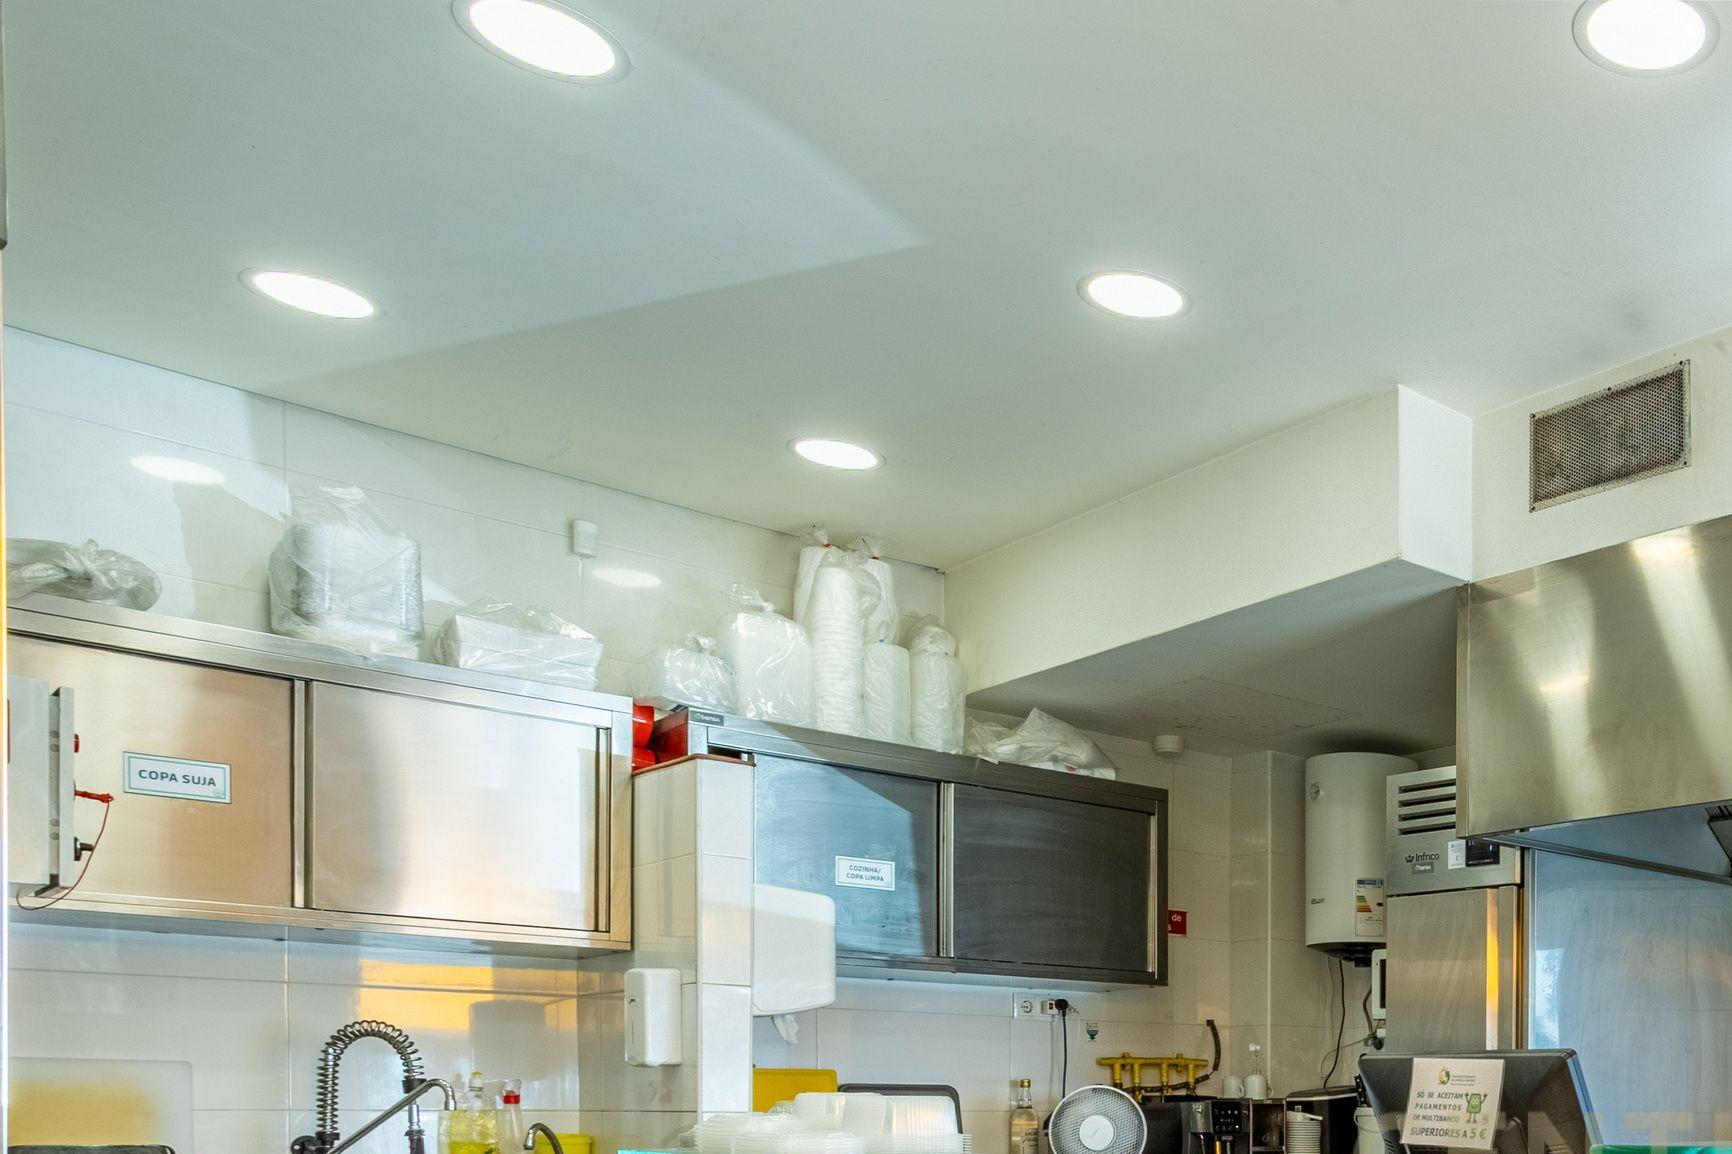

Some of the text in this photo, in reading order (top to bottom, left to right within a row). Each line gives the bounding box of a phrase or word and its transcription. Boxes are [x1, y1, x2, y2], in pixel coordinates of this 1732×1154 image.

[138, 769, 216, 787] COPA SUJA
[1415, 851, 1440, 862] Infrico
[848, 864, 881, 874] COZINHA/
[1171, 913, 1182, 922] de
[1414, 1103, 1462, 1111] PAGAMENTOS
[1410, 1126, 1488, 1139] SUPERIORES A 5 €
